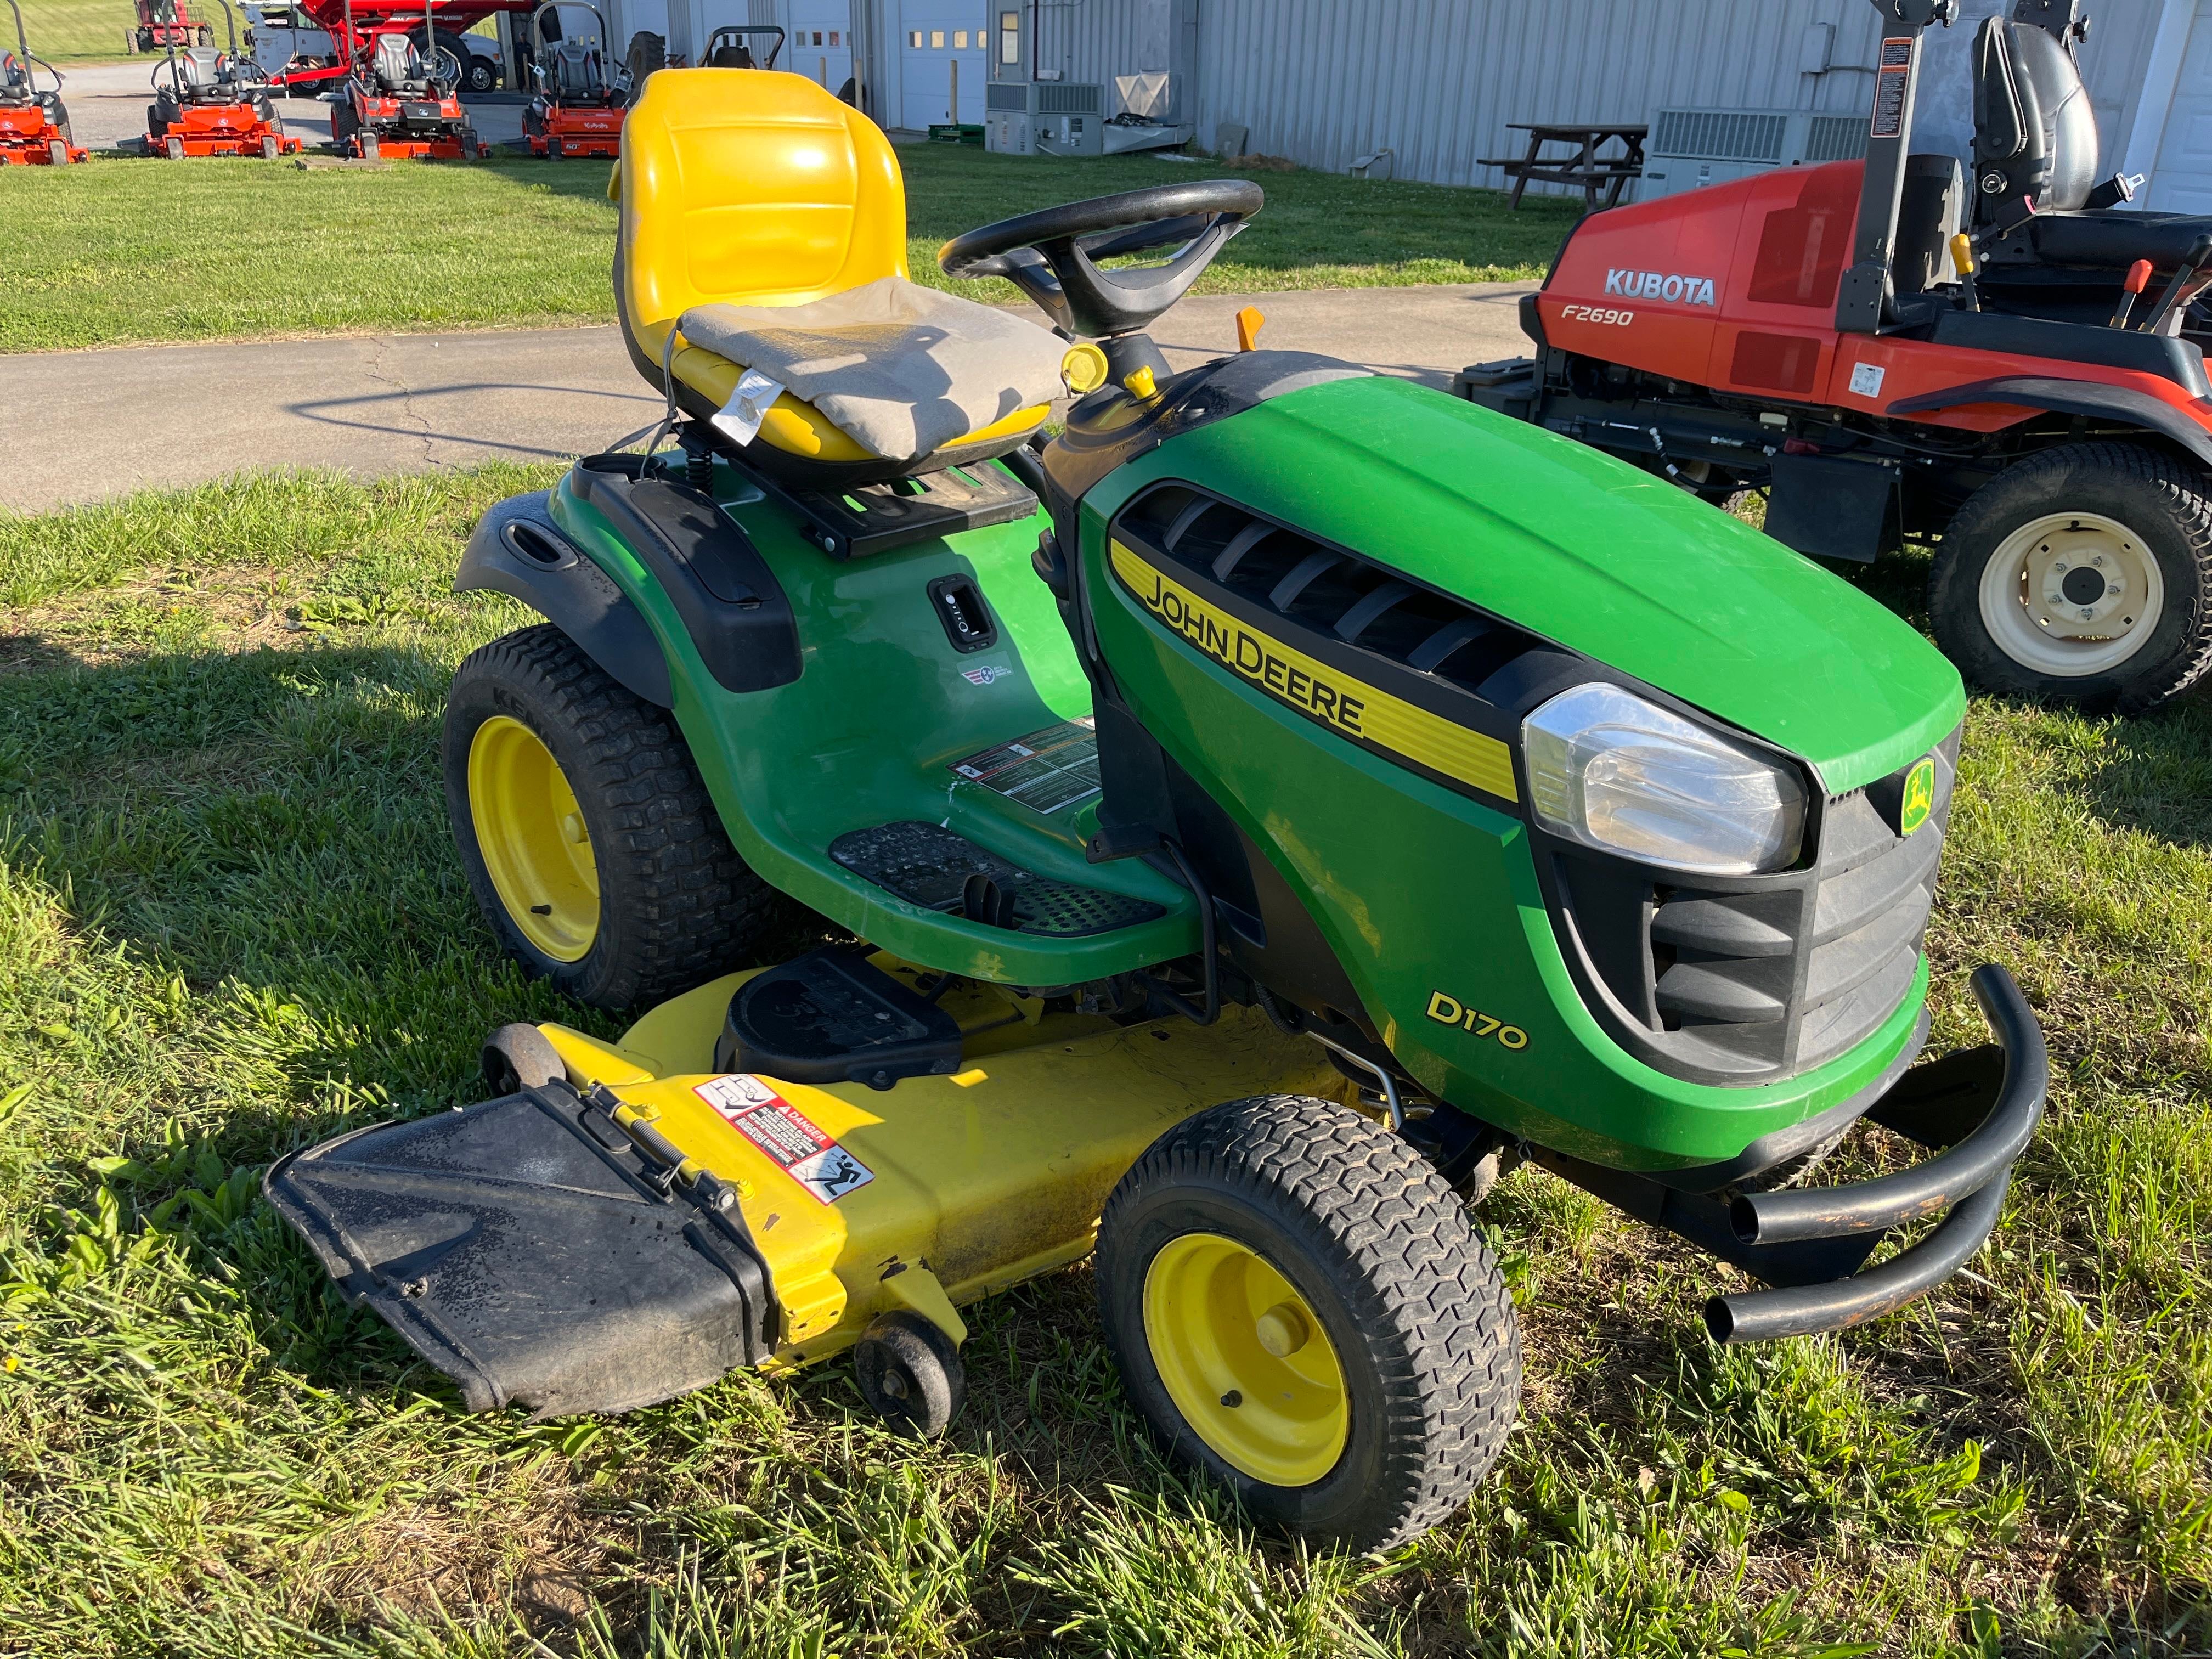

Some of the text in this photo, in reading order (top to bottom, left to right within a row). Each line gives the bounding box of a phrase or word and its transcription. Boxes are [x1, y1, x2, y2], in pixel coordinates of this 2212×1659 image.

[1604, 268, 1714, 306] KUBOTA
[1561, 304, 1634, 326] F2690
[1146, 575, 1364, 733] JOHN DEERE
[1426, 990, 1528, 1050] D170
[788, 1111, 827, 1142] DANGER
